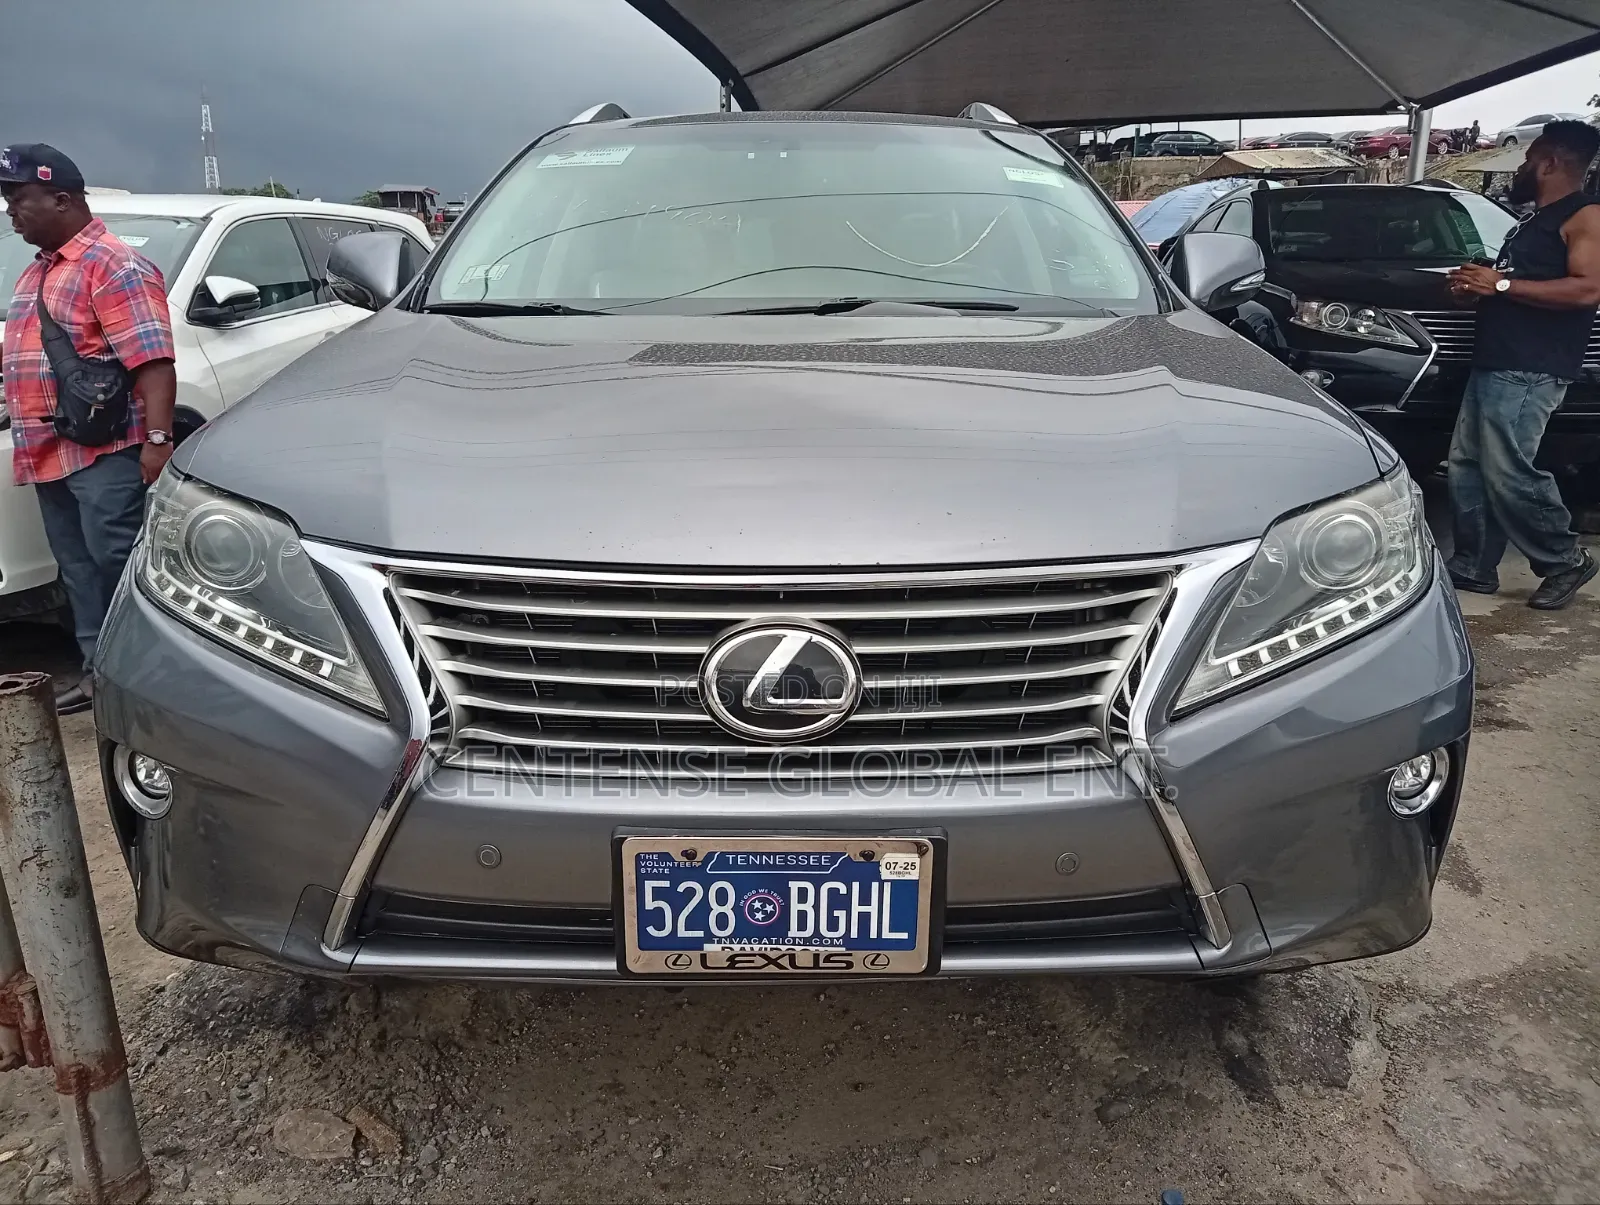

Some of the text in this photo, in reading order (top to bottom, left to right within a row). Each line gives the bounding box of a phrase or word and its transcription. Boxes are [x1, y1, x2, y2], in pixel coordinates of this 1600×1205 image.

[725, 854, 831, 866] TENNESSEE
[885, 861, 917, 871] 07-25
[743, 889, 757, 900] GOD
[770, 890, 785, 906] TRUST
[645, 880, 909, 940] 528 BGHL
[712, 937, 844, 946] TNVACATION.COM
[700, 952, 855, 971] LEXUS
